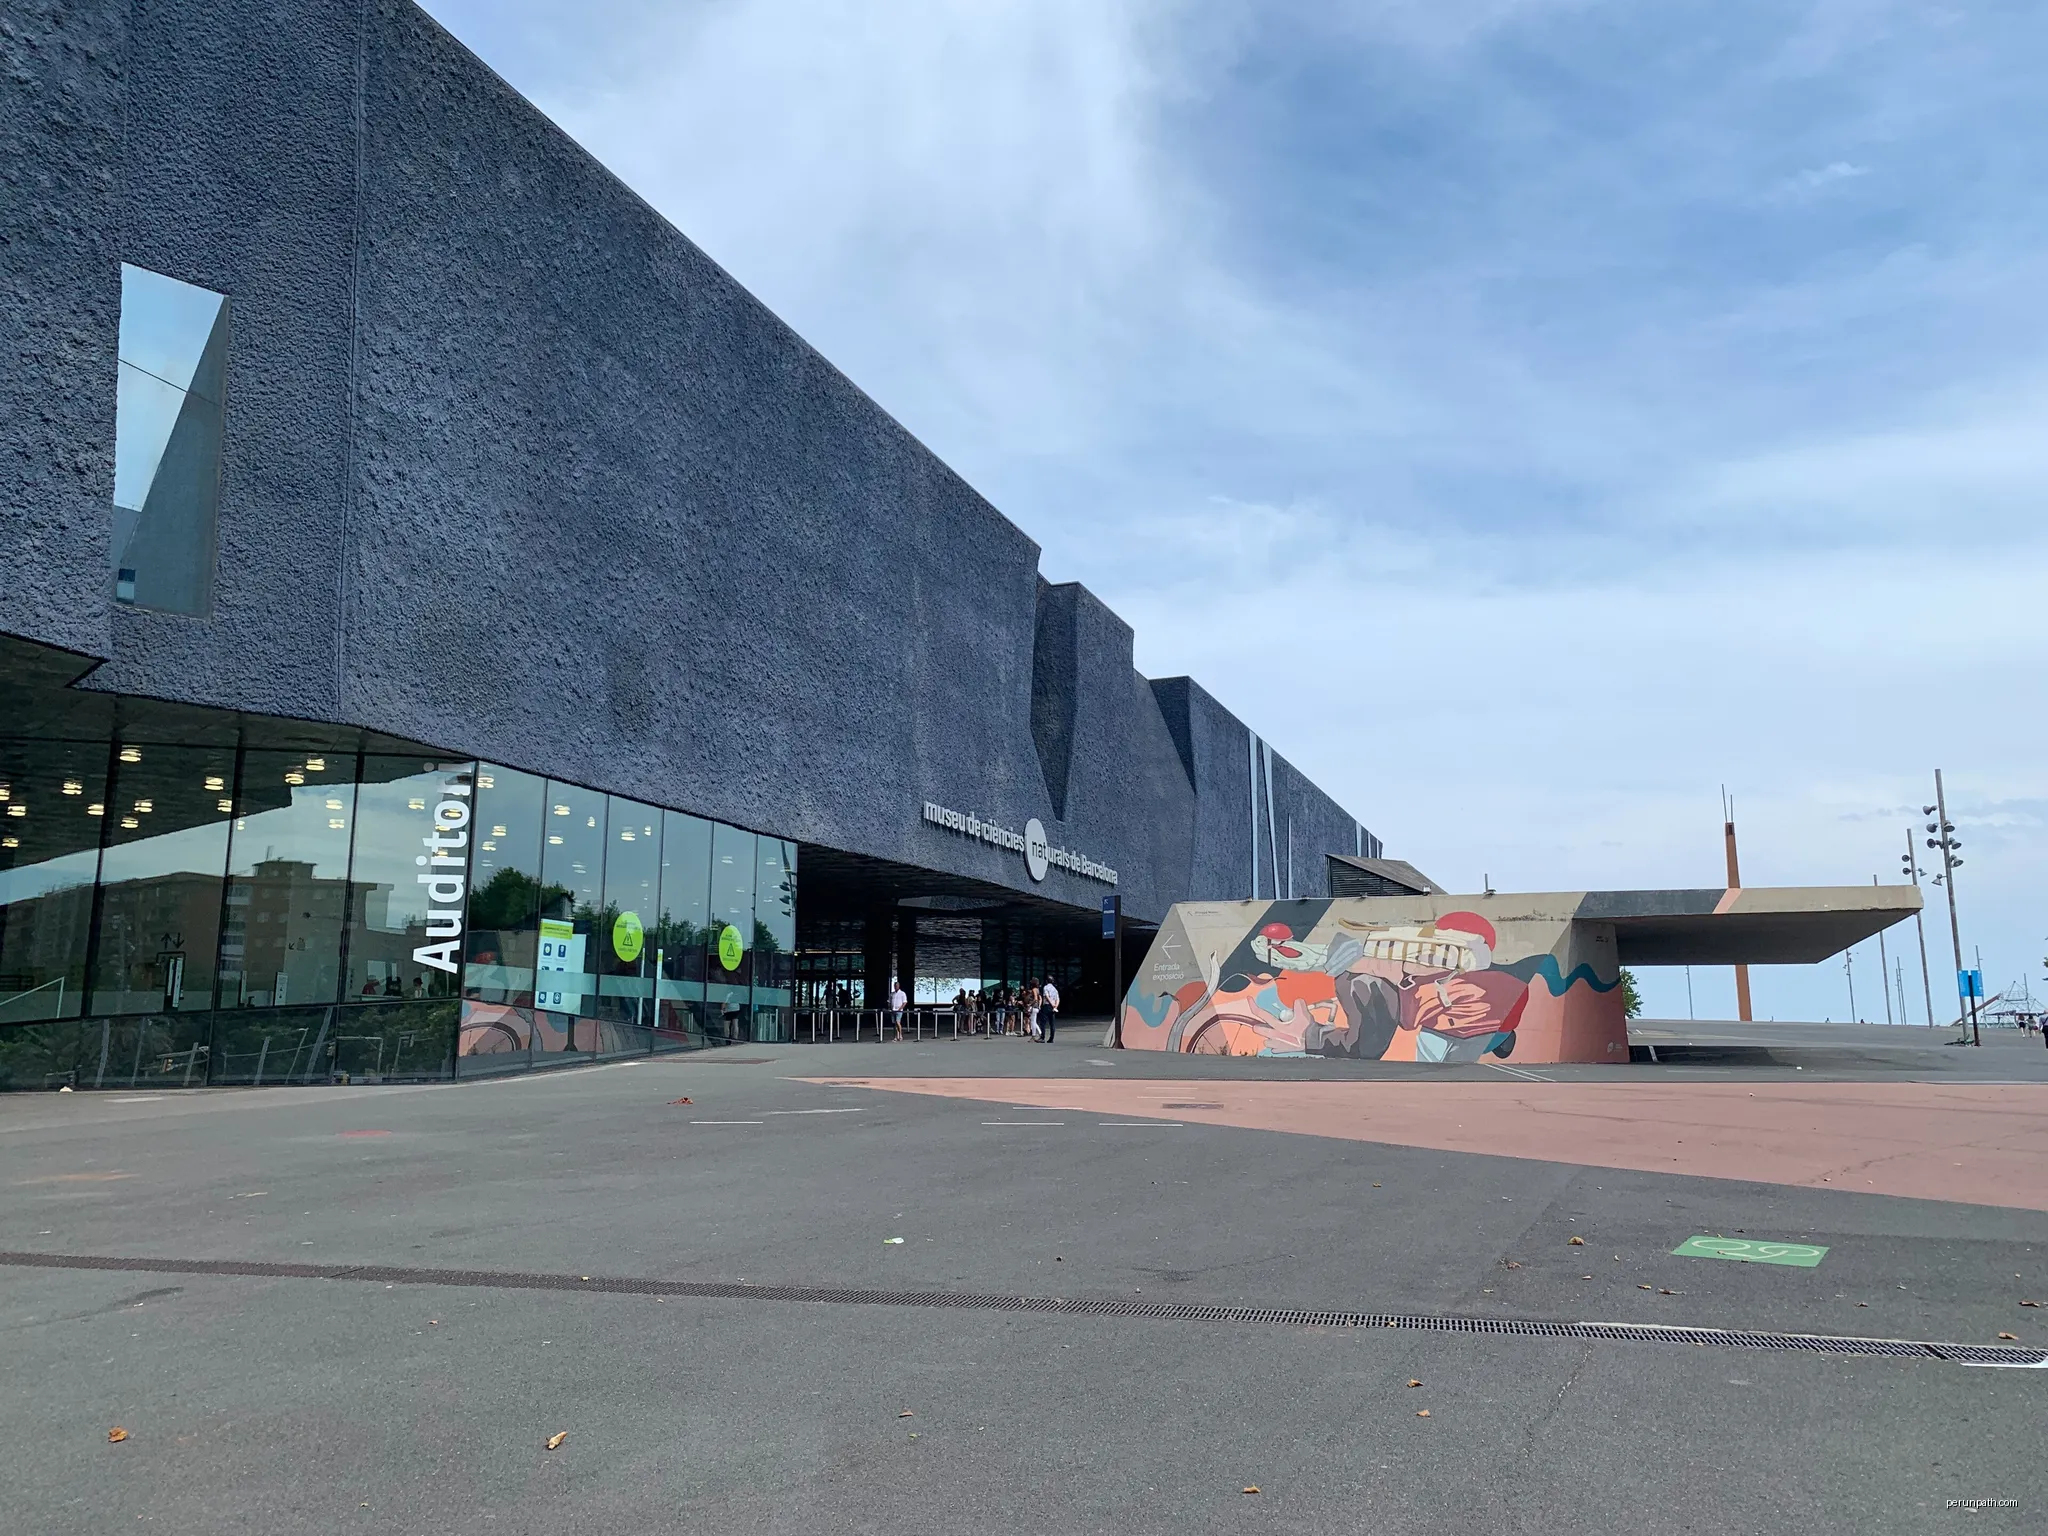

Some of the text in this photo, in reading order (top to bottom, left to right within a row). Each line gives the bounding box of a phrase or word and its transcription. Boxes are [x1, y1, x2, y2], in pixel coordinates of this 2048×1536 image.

[924, 801, 1118, 884] museu de ciències naturals de Barcelona
[1154, 963, 1180, 971] Entrada
[1153, 971, 1184, 981] exposició
